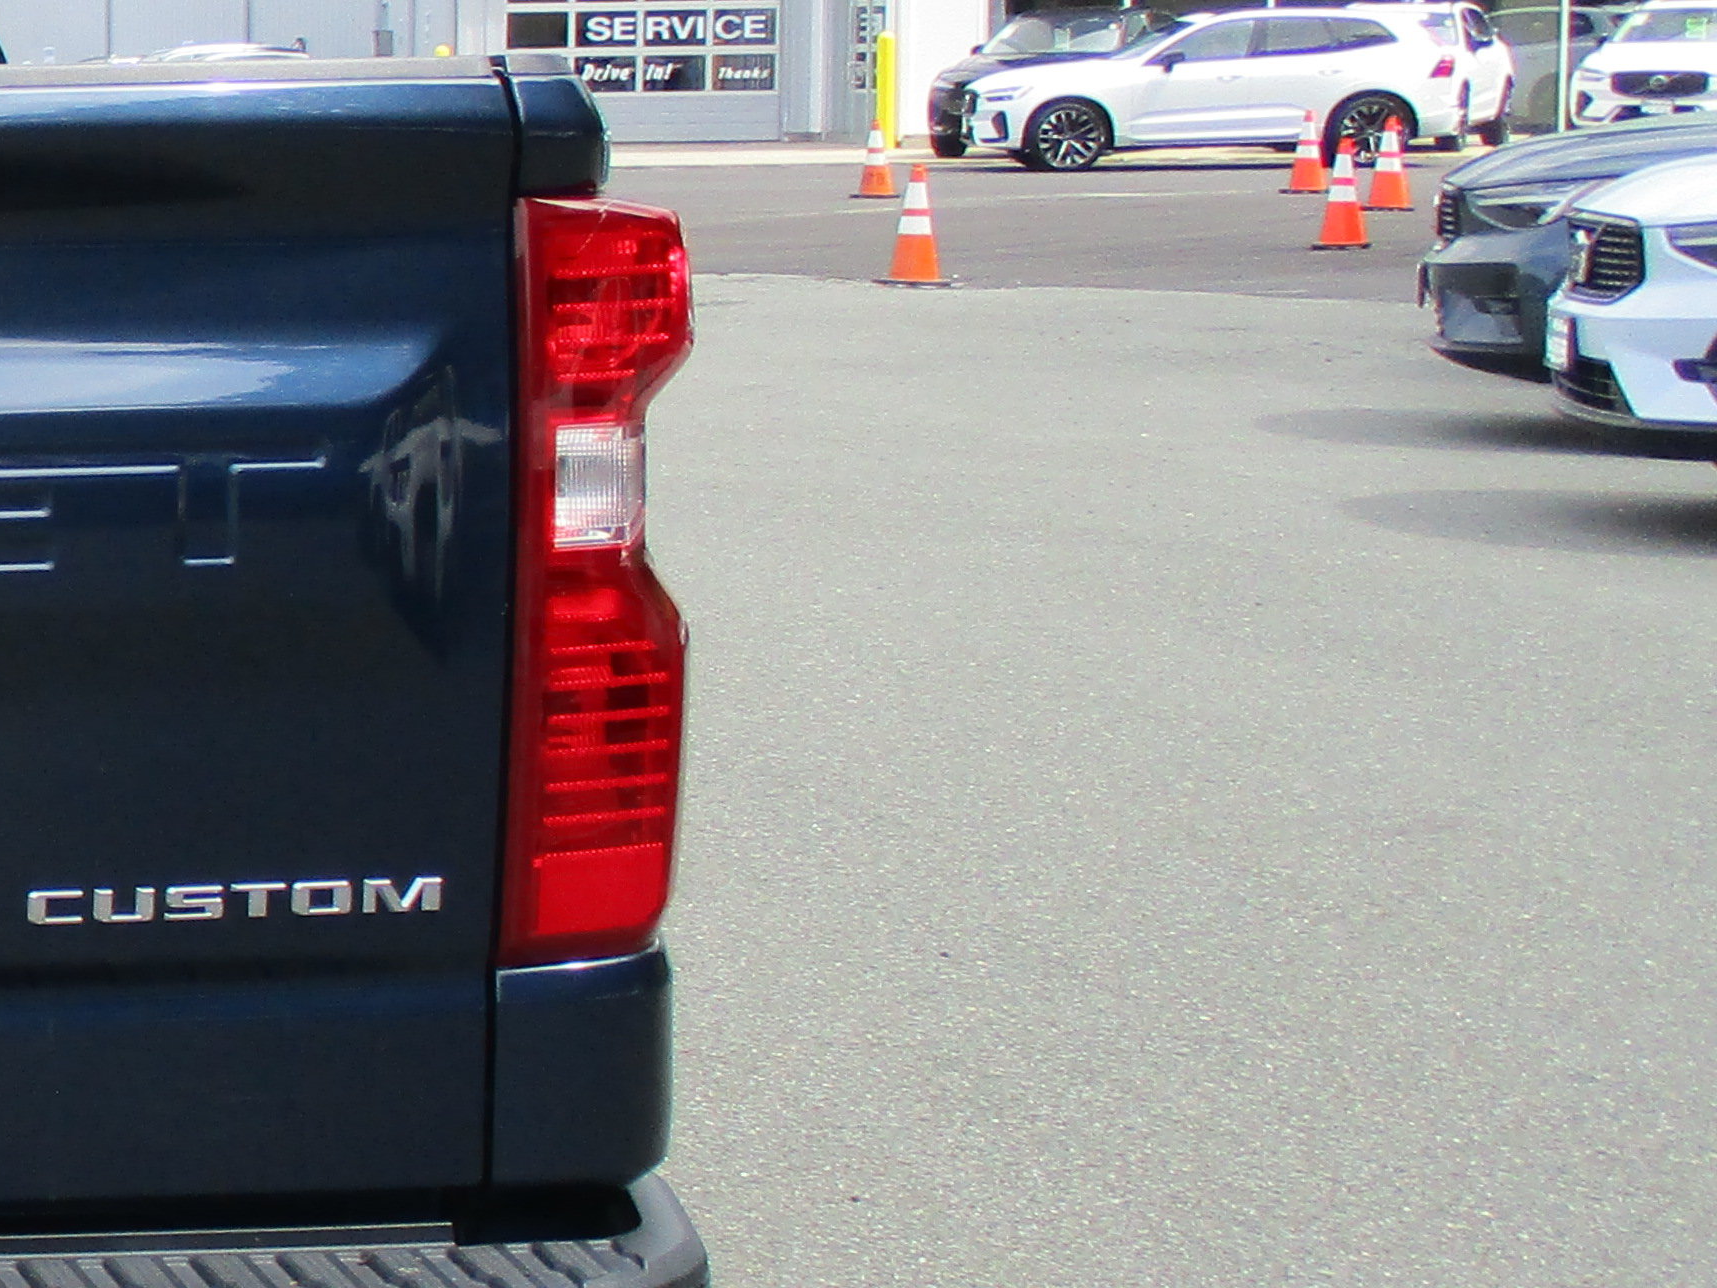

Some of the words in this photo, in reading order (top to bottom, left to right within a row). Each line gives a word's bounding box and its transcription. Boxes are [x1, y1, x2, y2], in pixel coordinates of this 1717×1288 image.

[585, 15, 767, 41] SERVICE
[580, 63, 632, 82] Drive
[717, 66, 772, 80] Thanks
[27, 876, 443, 925] CUSTOM
